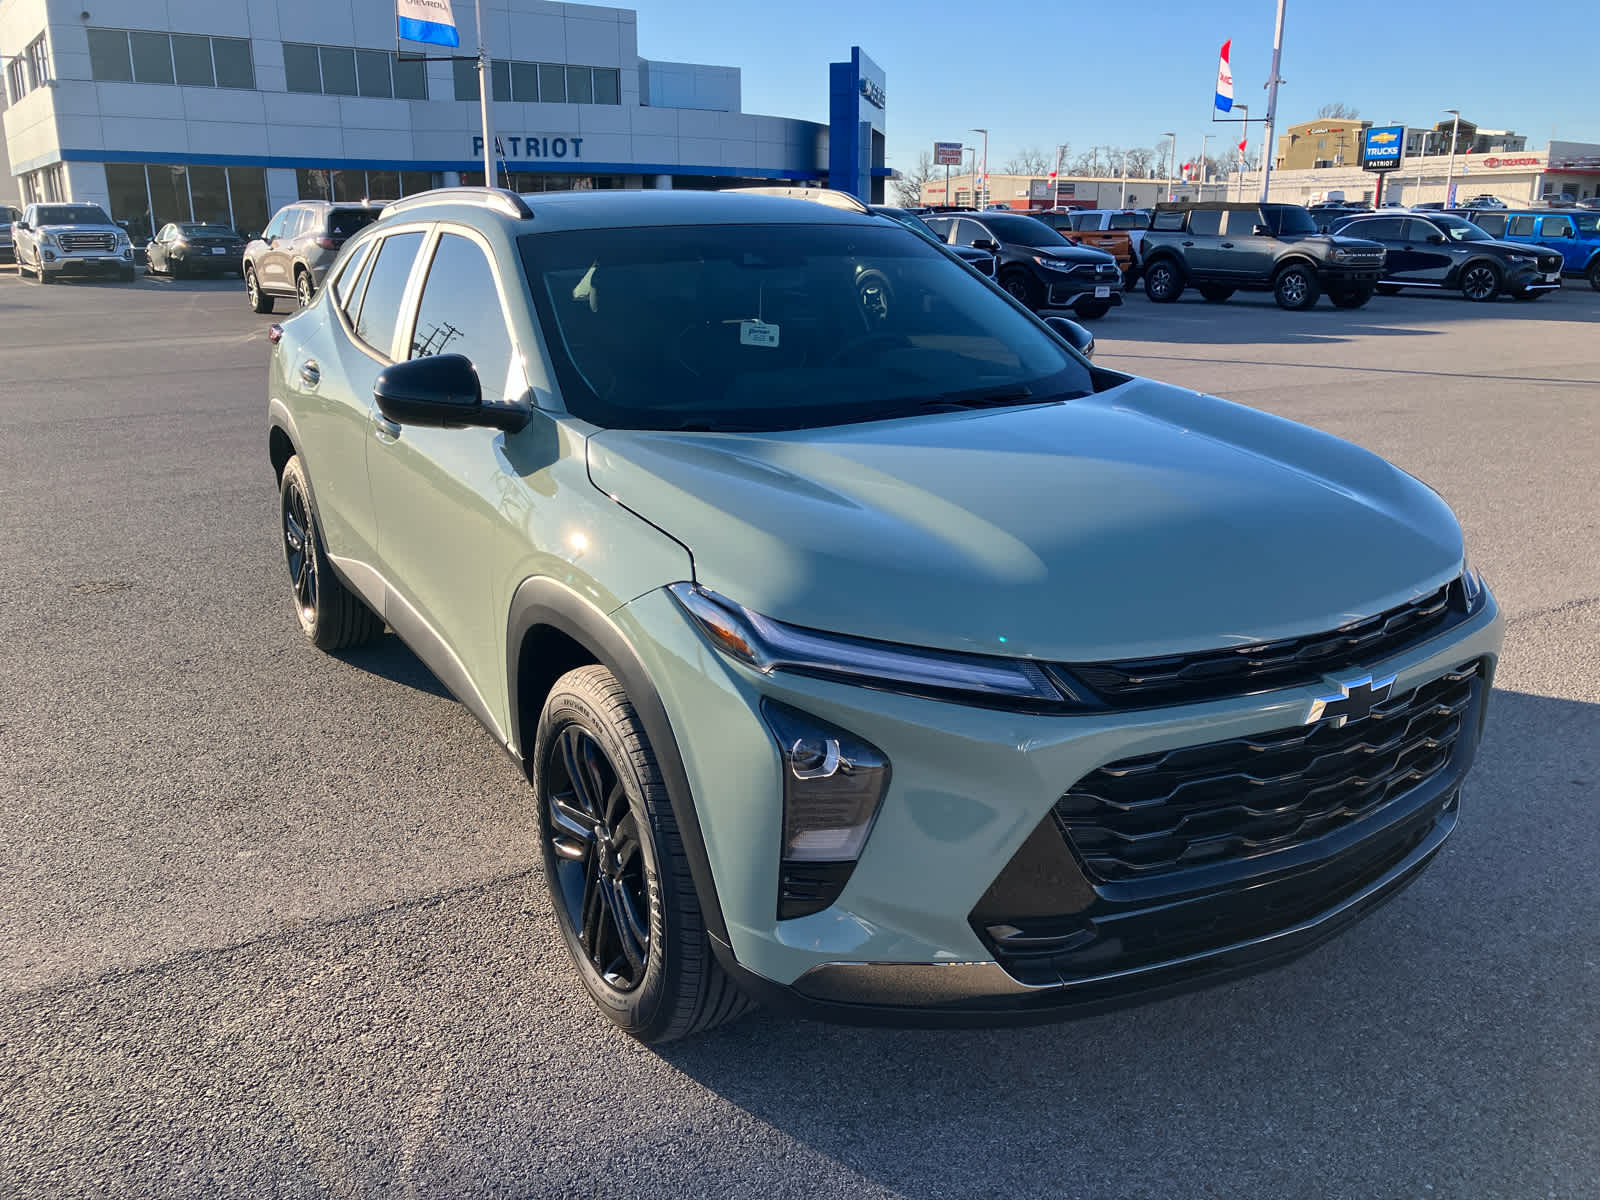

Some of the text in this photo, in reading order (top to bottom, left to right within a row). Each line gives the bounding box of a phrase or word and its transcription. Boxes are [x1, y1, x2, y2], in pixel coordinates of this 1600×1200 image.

[472, 136, 584, 158] PATRIOT
[1367, 147, 1399, 156] TRUCKS
[1369, 160, 1393, 168] PATRIOT
[1502, 158, 1537, 166] TOYOTA
